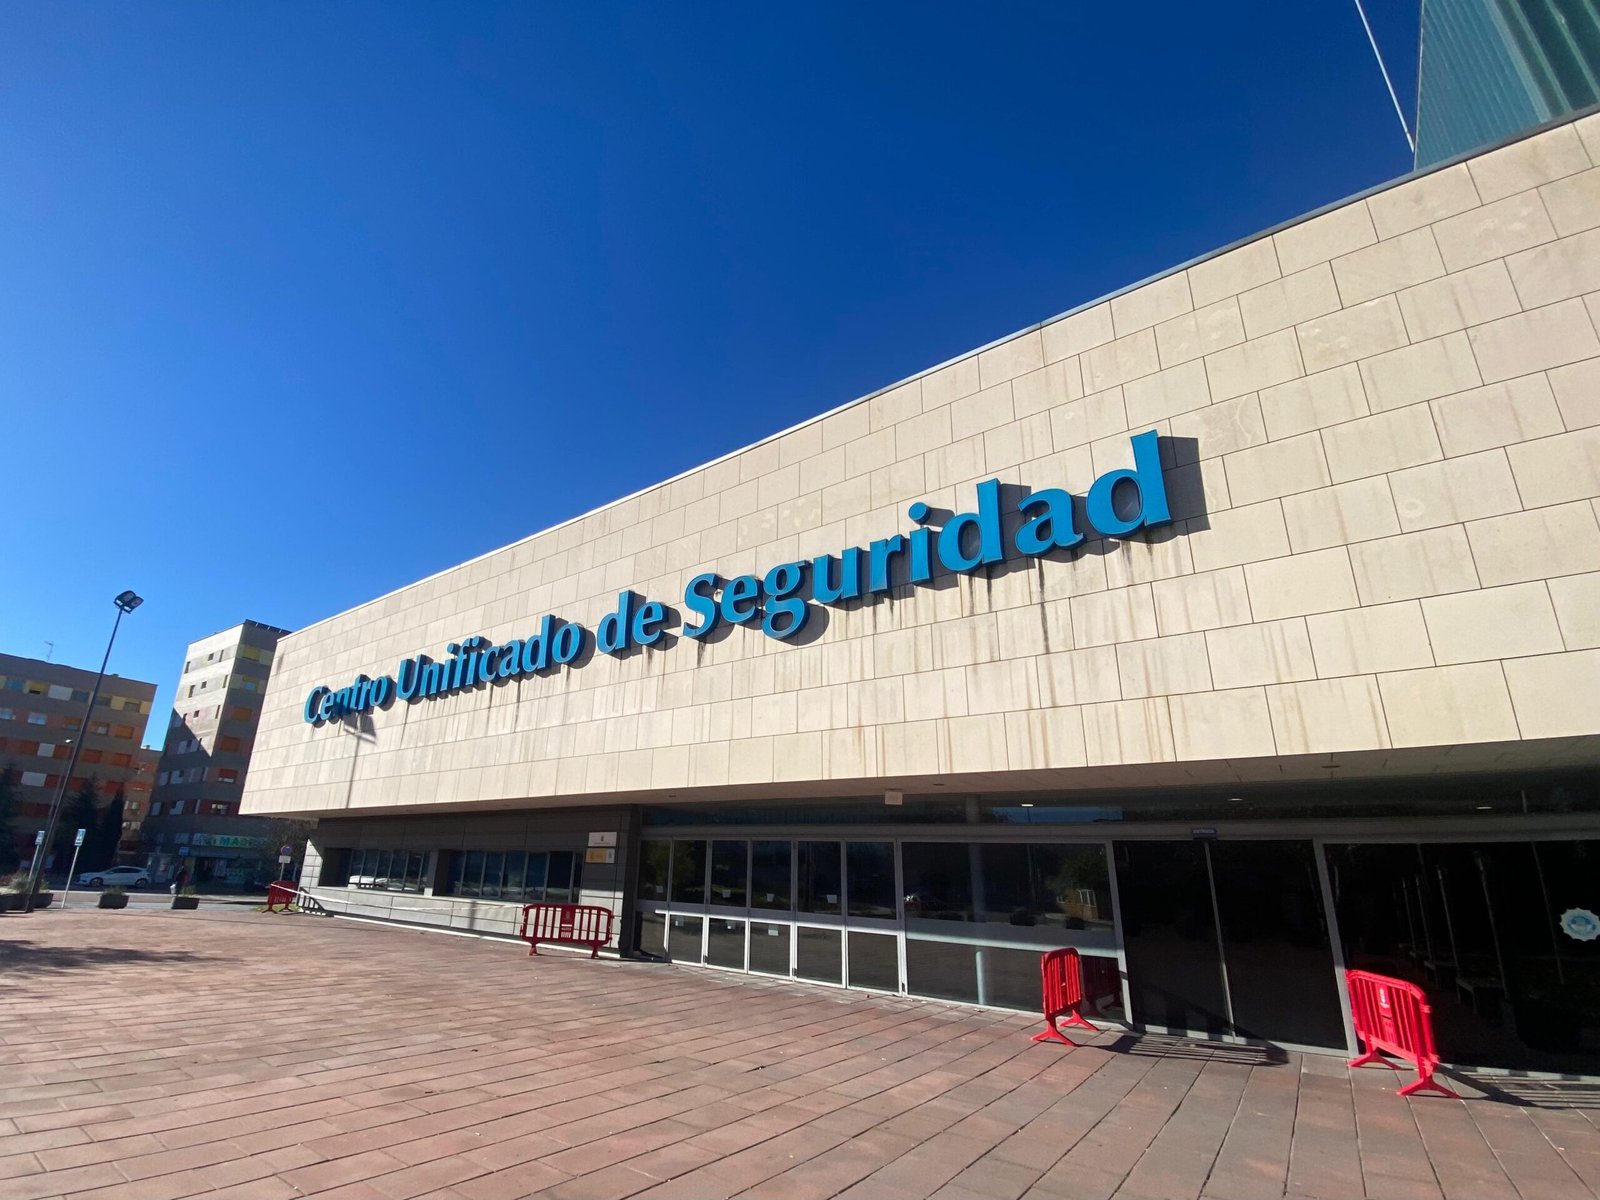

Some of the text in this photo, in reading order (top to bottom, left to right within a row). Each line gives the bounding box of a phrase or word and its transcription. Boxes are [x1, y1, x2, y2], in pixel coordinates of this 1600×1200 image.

[304, 430, 1172, 724] Centro Unificado de Seguridad
